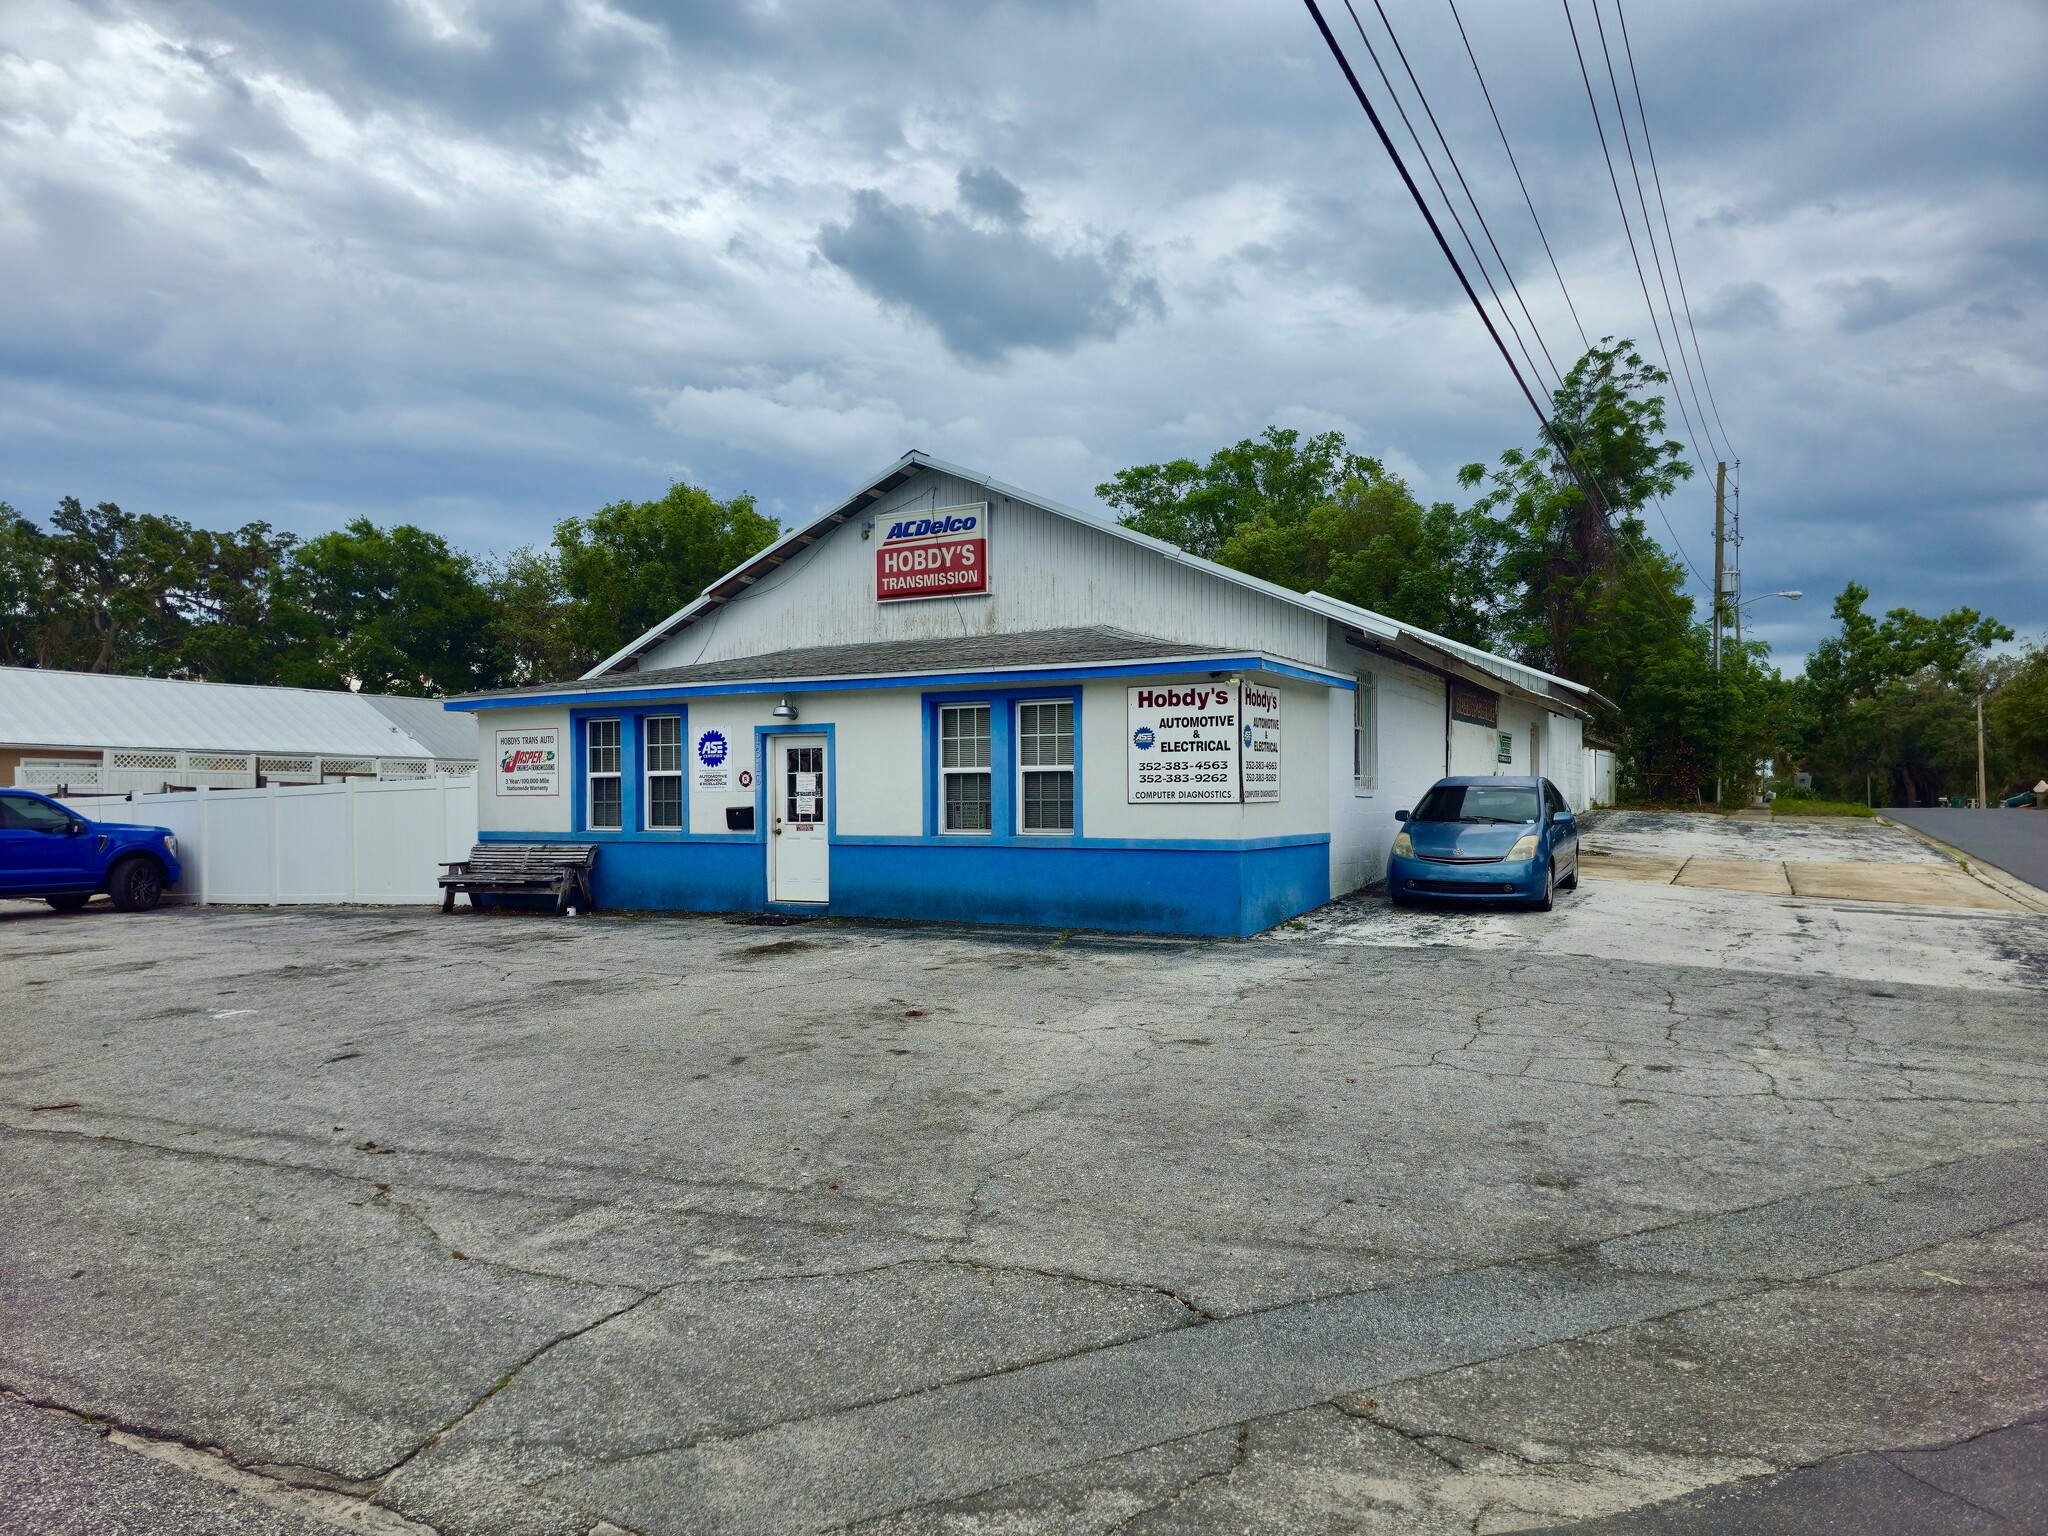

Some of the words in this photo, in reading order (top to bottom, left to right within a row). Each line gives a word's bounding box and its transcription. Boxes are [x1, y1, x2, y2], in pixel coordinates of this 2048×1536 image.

[886, 516, 977, 539] ACDelco
[885, 544, 975, 573] HOBDY'S
[882, 570, 978, 590] TRANSMISSION
[1138, 687, 1228, 710] Hobdy's
[1245, 687, 1277, 713] Hobdy's
[1159, 715, 1235, 728] AUTOMOTIVE
[500, 737, 520, 745] HOBDYS
[522, 736, 539, 744] TRANS
[1135, 733, 1153, 741] ASE
[1193, 730, 1200, 739] &
[702, 741, 723, 754] ASE
[1160, 740, 1231, 752] ELECTRICAL
[504, 750, 543, 773] JASPER
[1138, 761, 1228, 771] 352-383-4563
[1139, 773, 1228, 783] 352-383-9262
[1135, 791, 1175, 799] COMPUTER
[1178, 790, 1232, 799] DIAGNOSTICS
